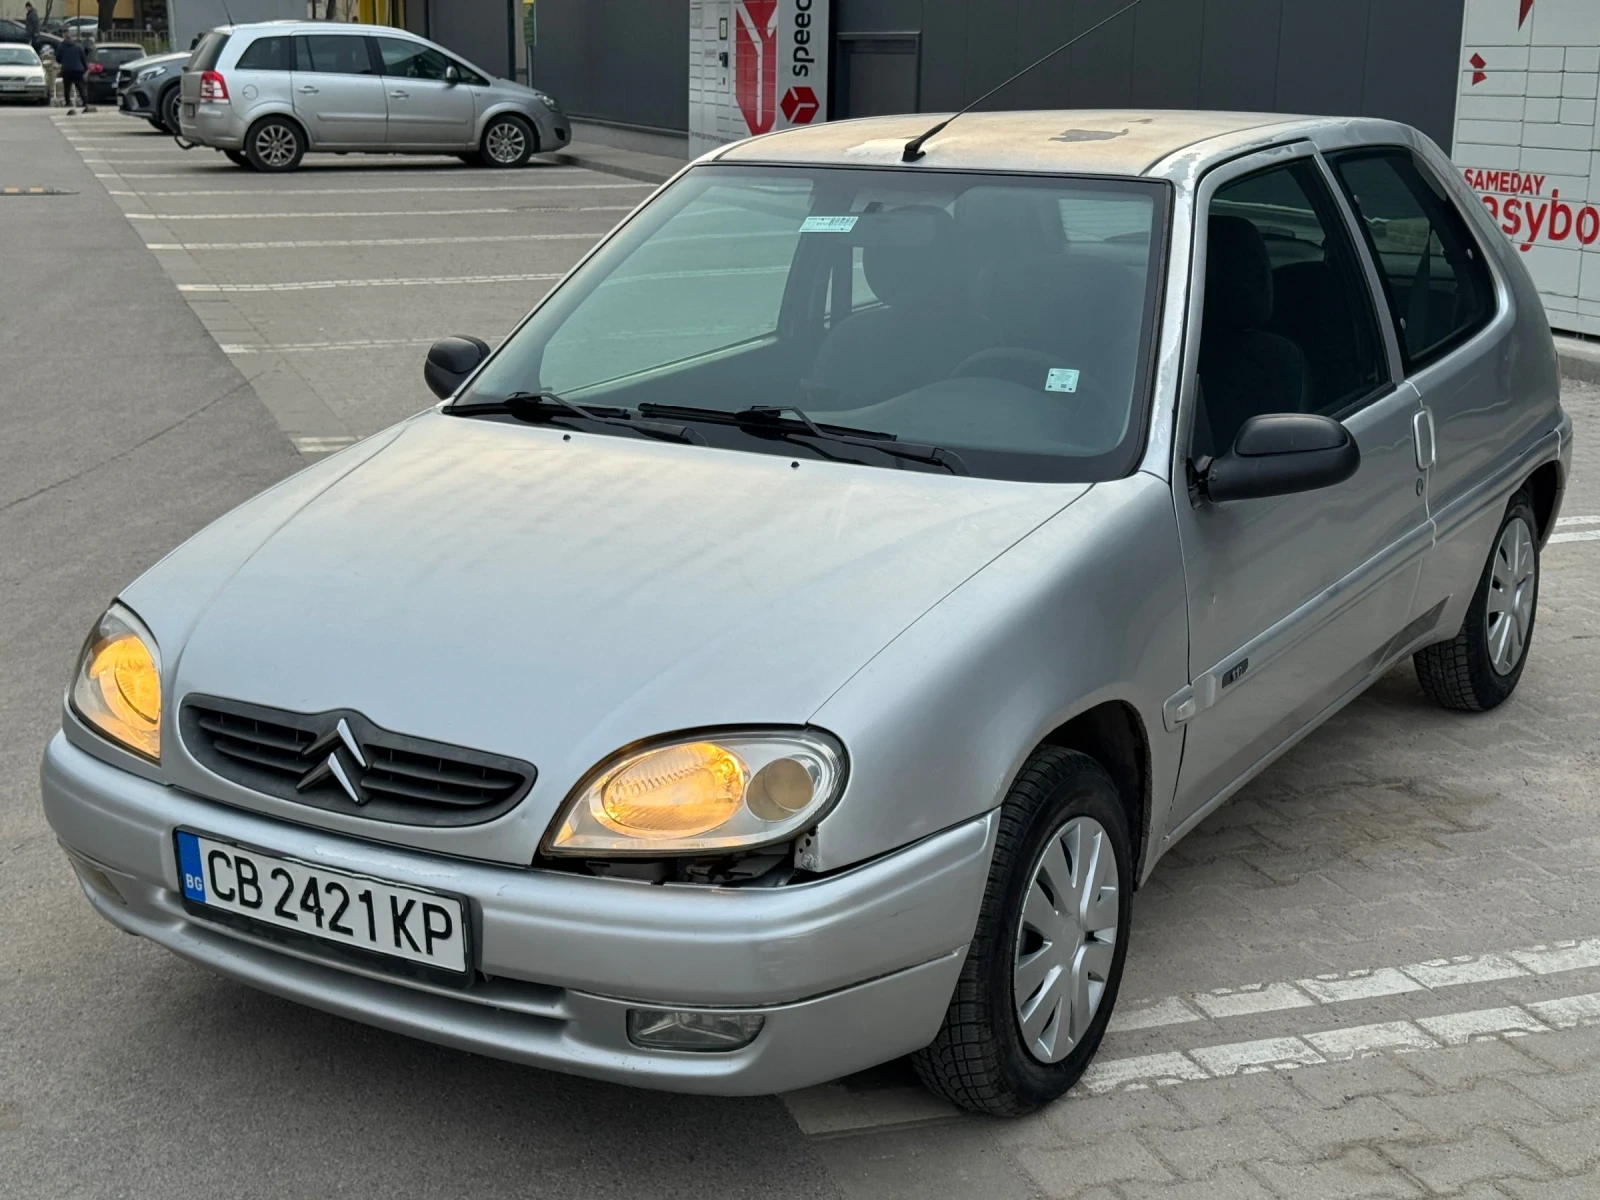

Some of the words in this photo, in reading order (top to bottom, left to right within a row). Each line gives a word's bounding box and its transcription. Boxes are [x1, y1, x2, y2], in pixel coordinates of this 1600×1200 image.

[1464, 168, 1546, 196] SAMEDAY
[185, 873, 203, 892] BG
[270, 867, 377, 942] 2421
